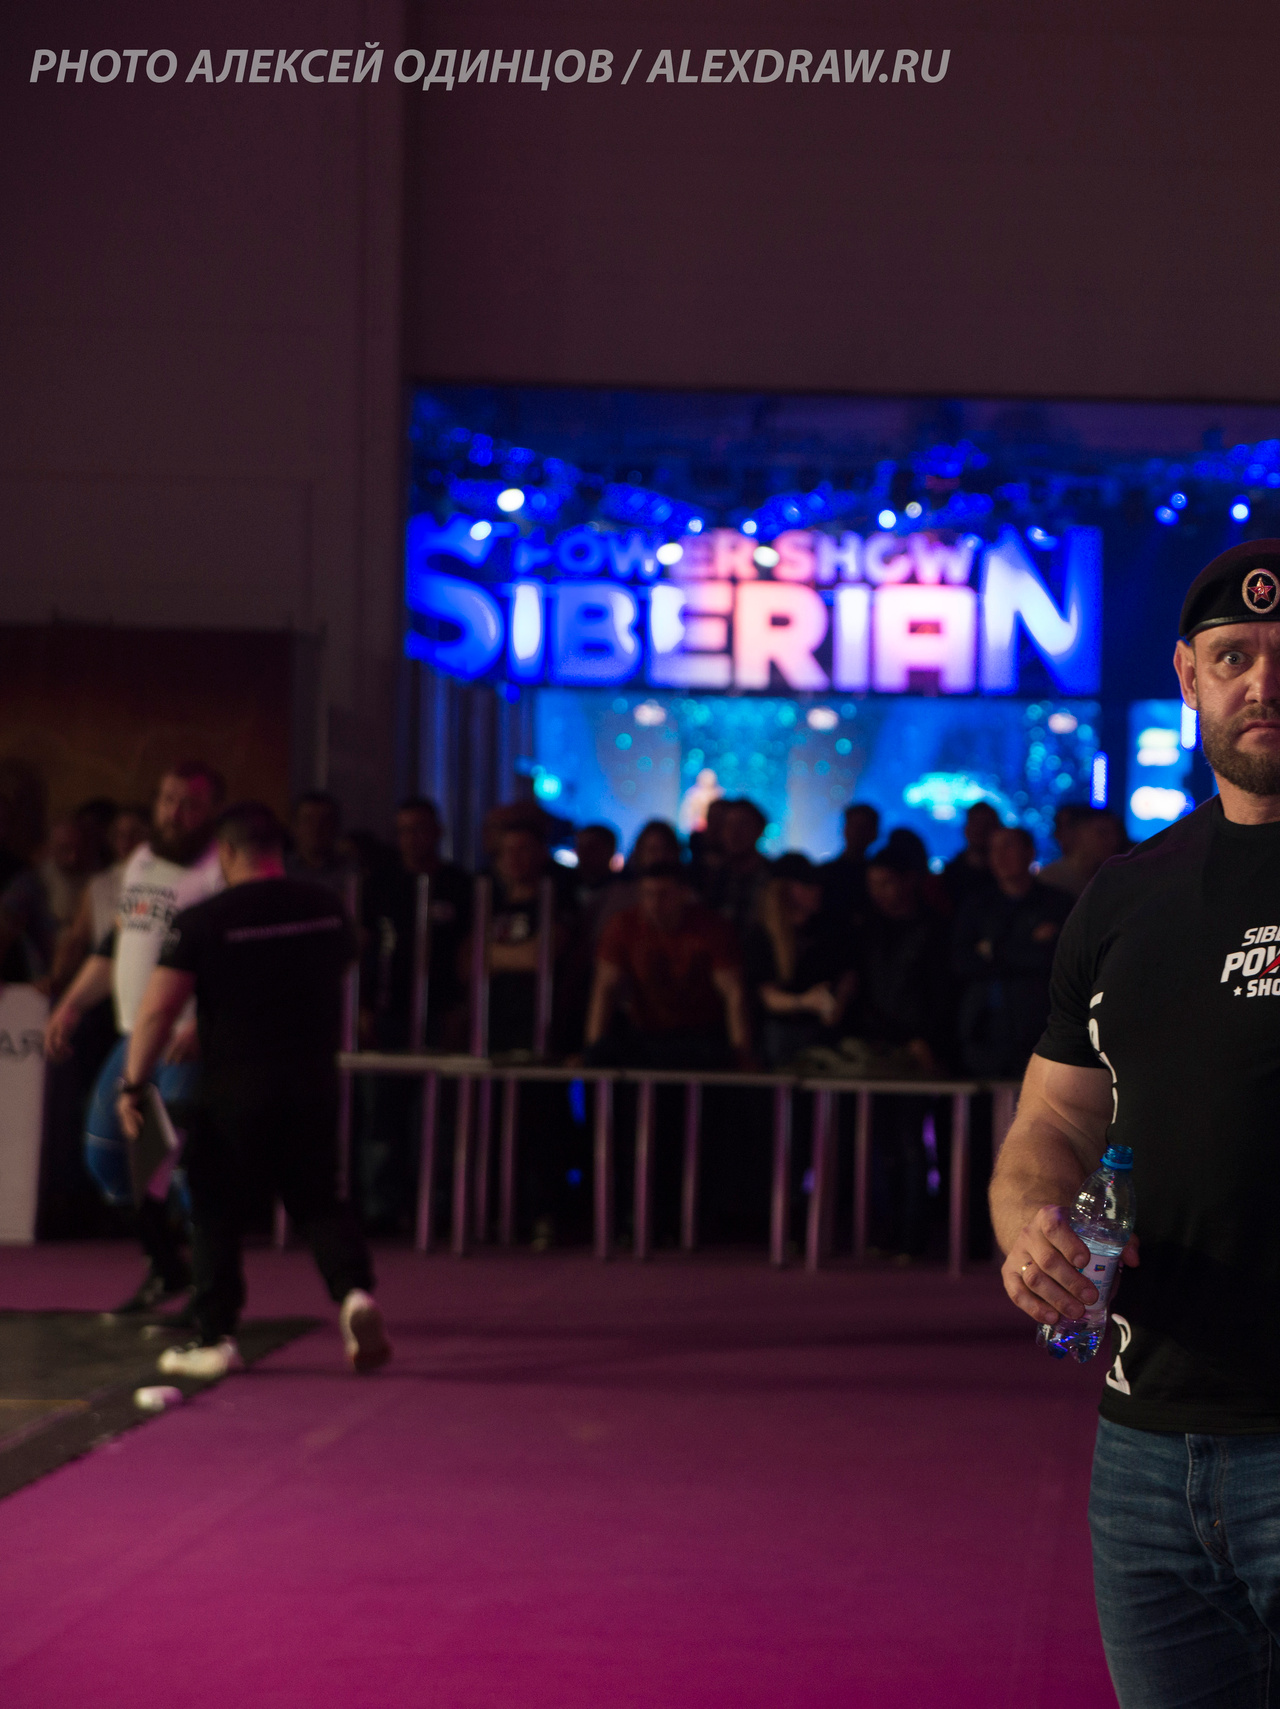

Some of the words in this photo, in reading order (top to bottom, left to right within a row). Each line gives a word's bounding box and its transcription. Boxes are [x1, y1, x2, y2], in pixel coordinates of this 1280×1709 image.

[404, 512, 1102, 694] SIBERIAN
[512, 525, 760, 580] POWER
[772, 528, 980, 586] SHOW
